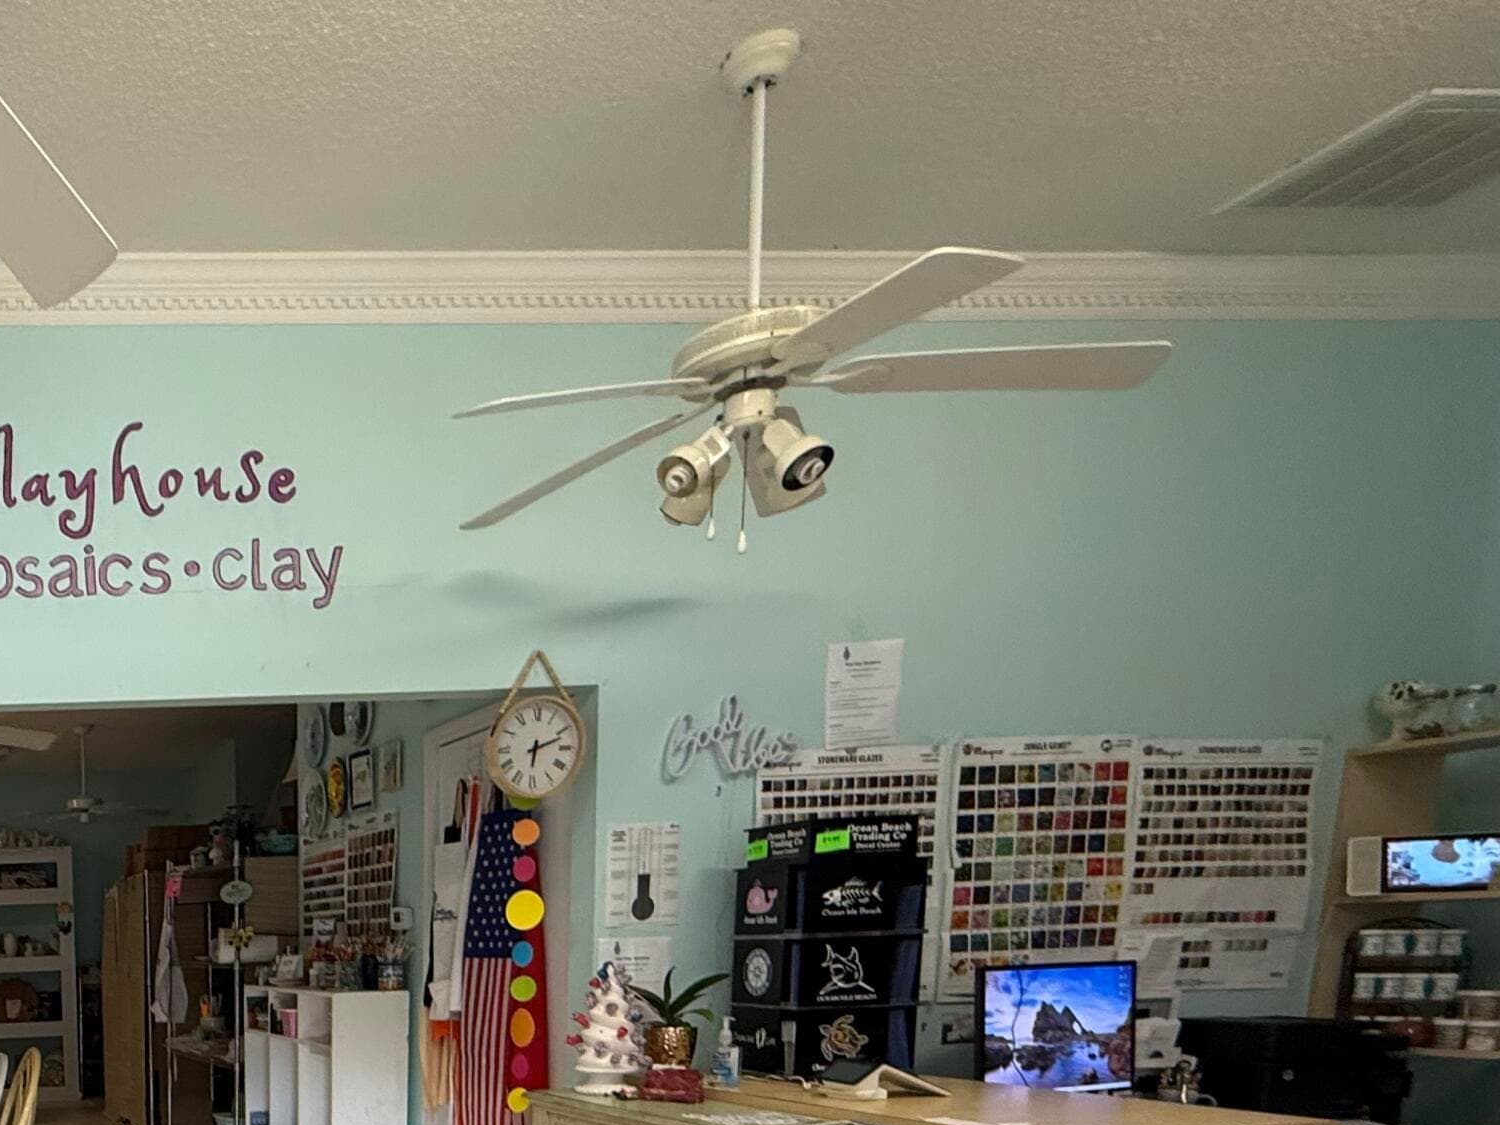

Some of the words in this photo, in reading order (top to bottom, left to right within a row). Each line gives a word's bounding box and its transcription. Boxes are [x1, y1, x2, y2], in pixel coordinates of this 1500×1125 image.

[211, 537, 344, 610] clay
[848, 824, 879, 834] Ocean
[881, 822, 912, 833] Beach
[851, 832, 890, 843] Trading
[892, 831, 907, 841] Co
